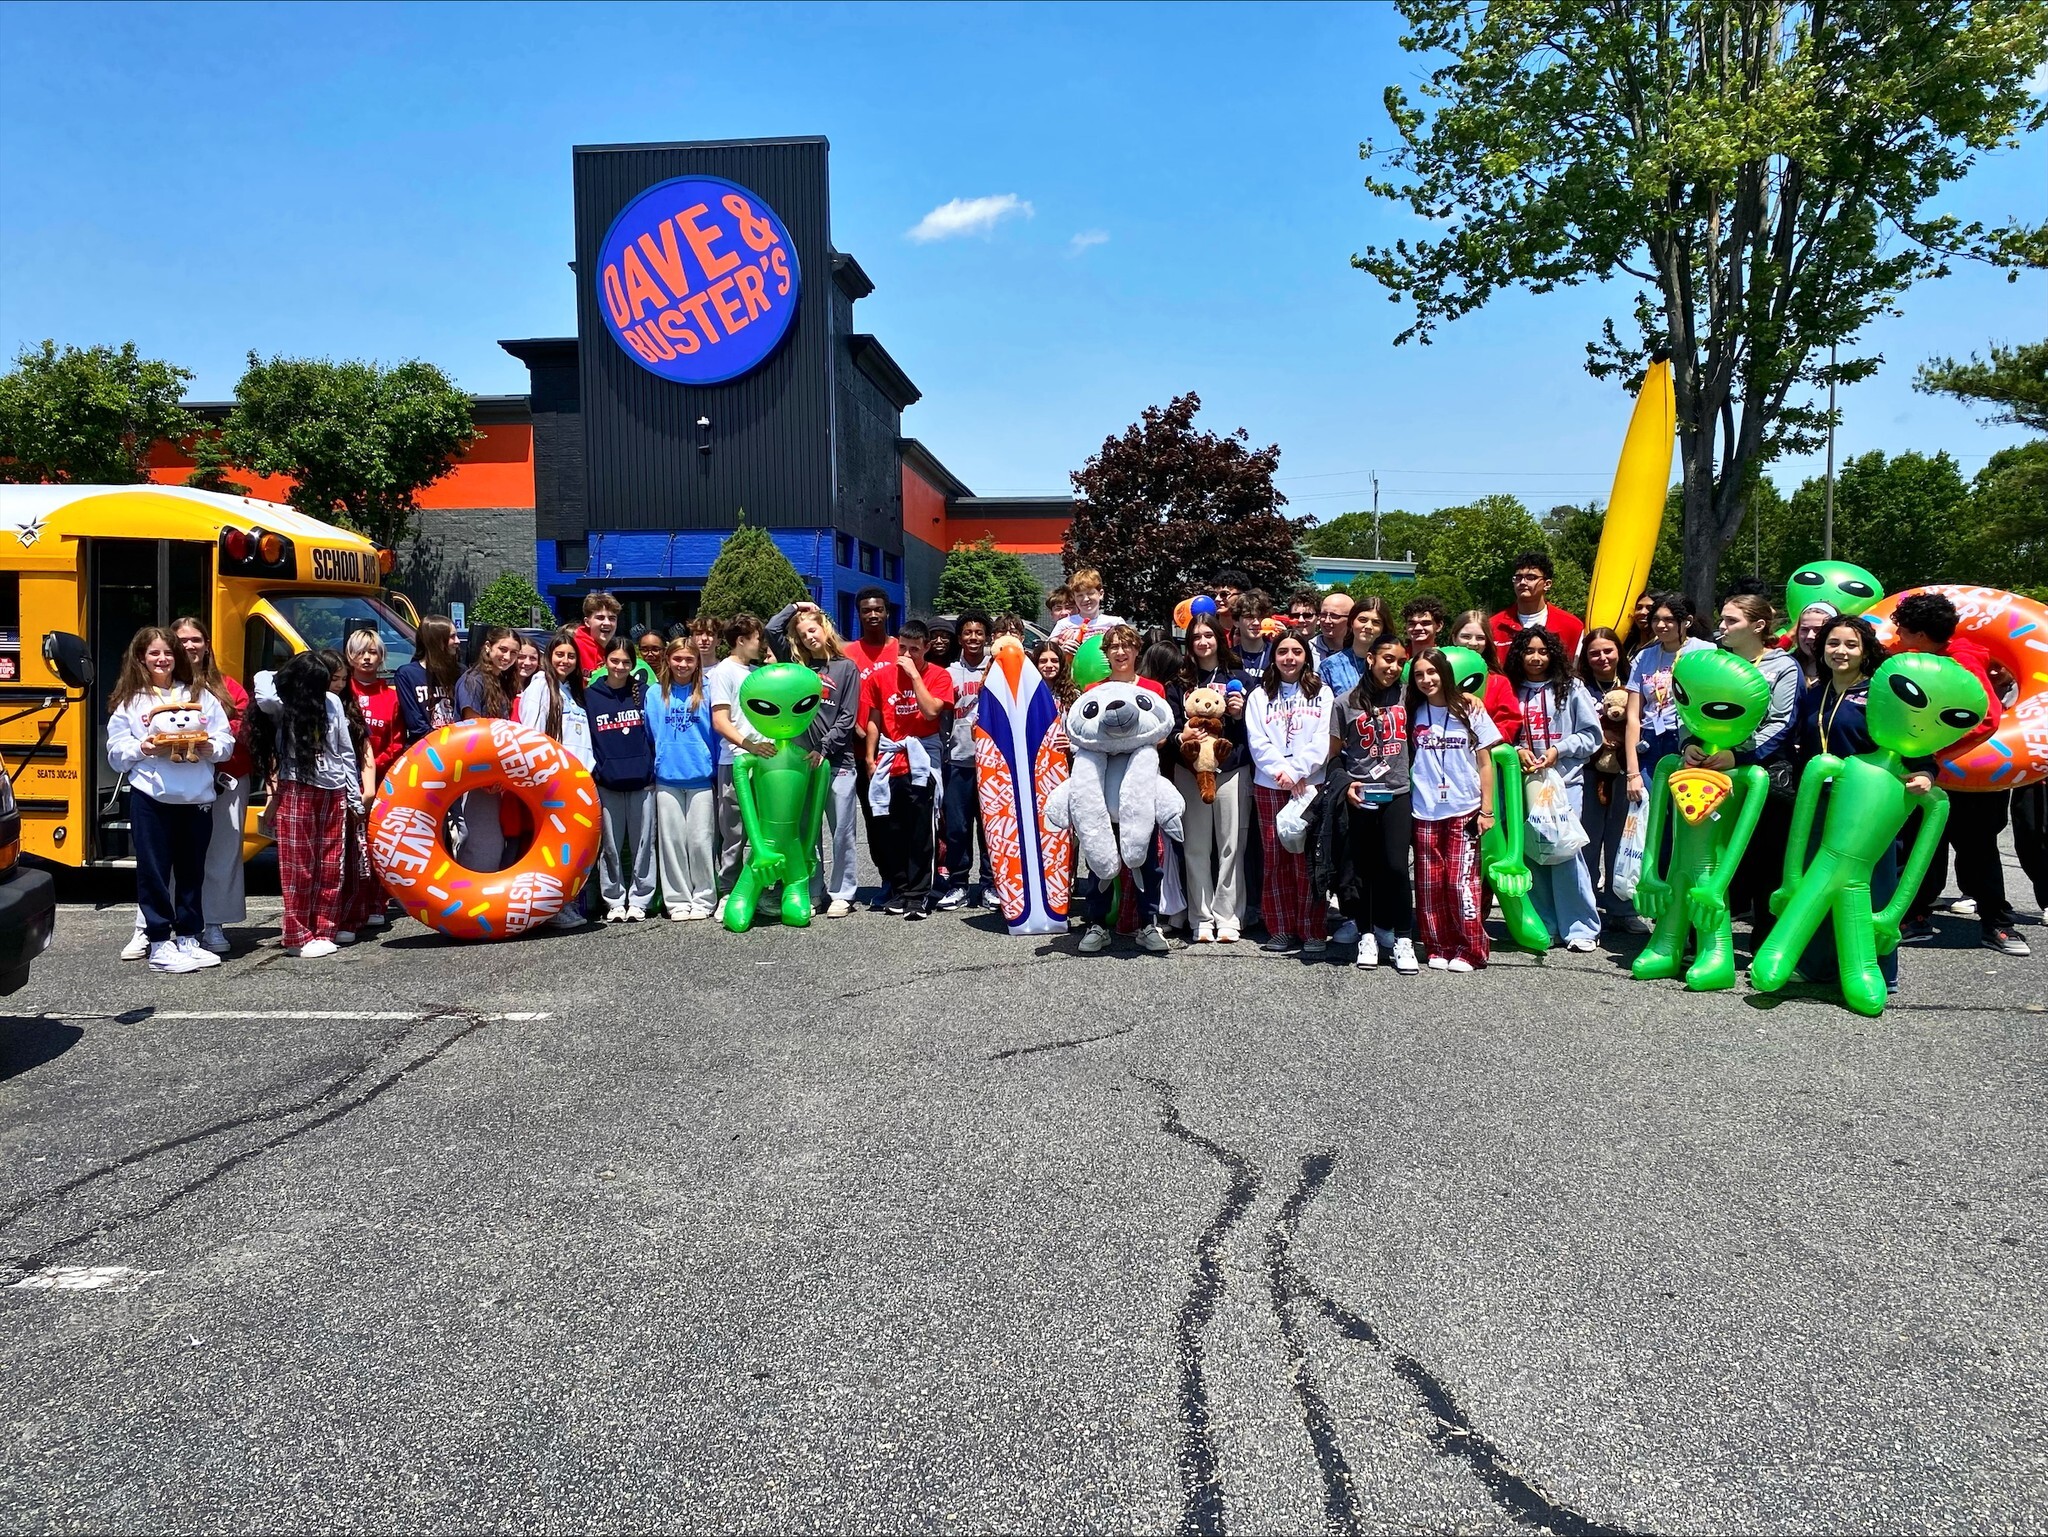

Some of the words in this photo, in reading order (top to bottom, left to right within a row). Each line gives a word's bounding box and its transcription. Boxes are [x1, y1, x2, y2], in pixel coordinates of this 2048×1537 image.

[603, 202, 742, 329] DAVE
[721, 193, 780, 253] &
[622, 247, 791, 363] BUSTER'S
[312, 548, 361, 583] SCHOOL
[362, 553, 377, 584] BUS
[1369, 742, 1402, 758] CEER
[37, 769, 55, 779] SEATS
[389, 809, 437, 874] DAVE
[384, 871, 417, 887] &
